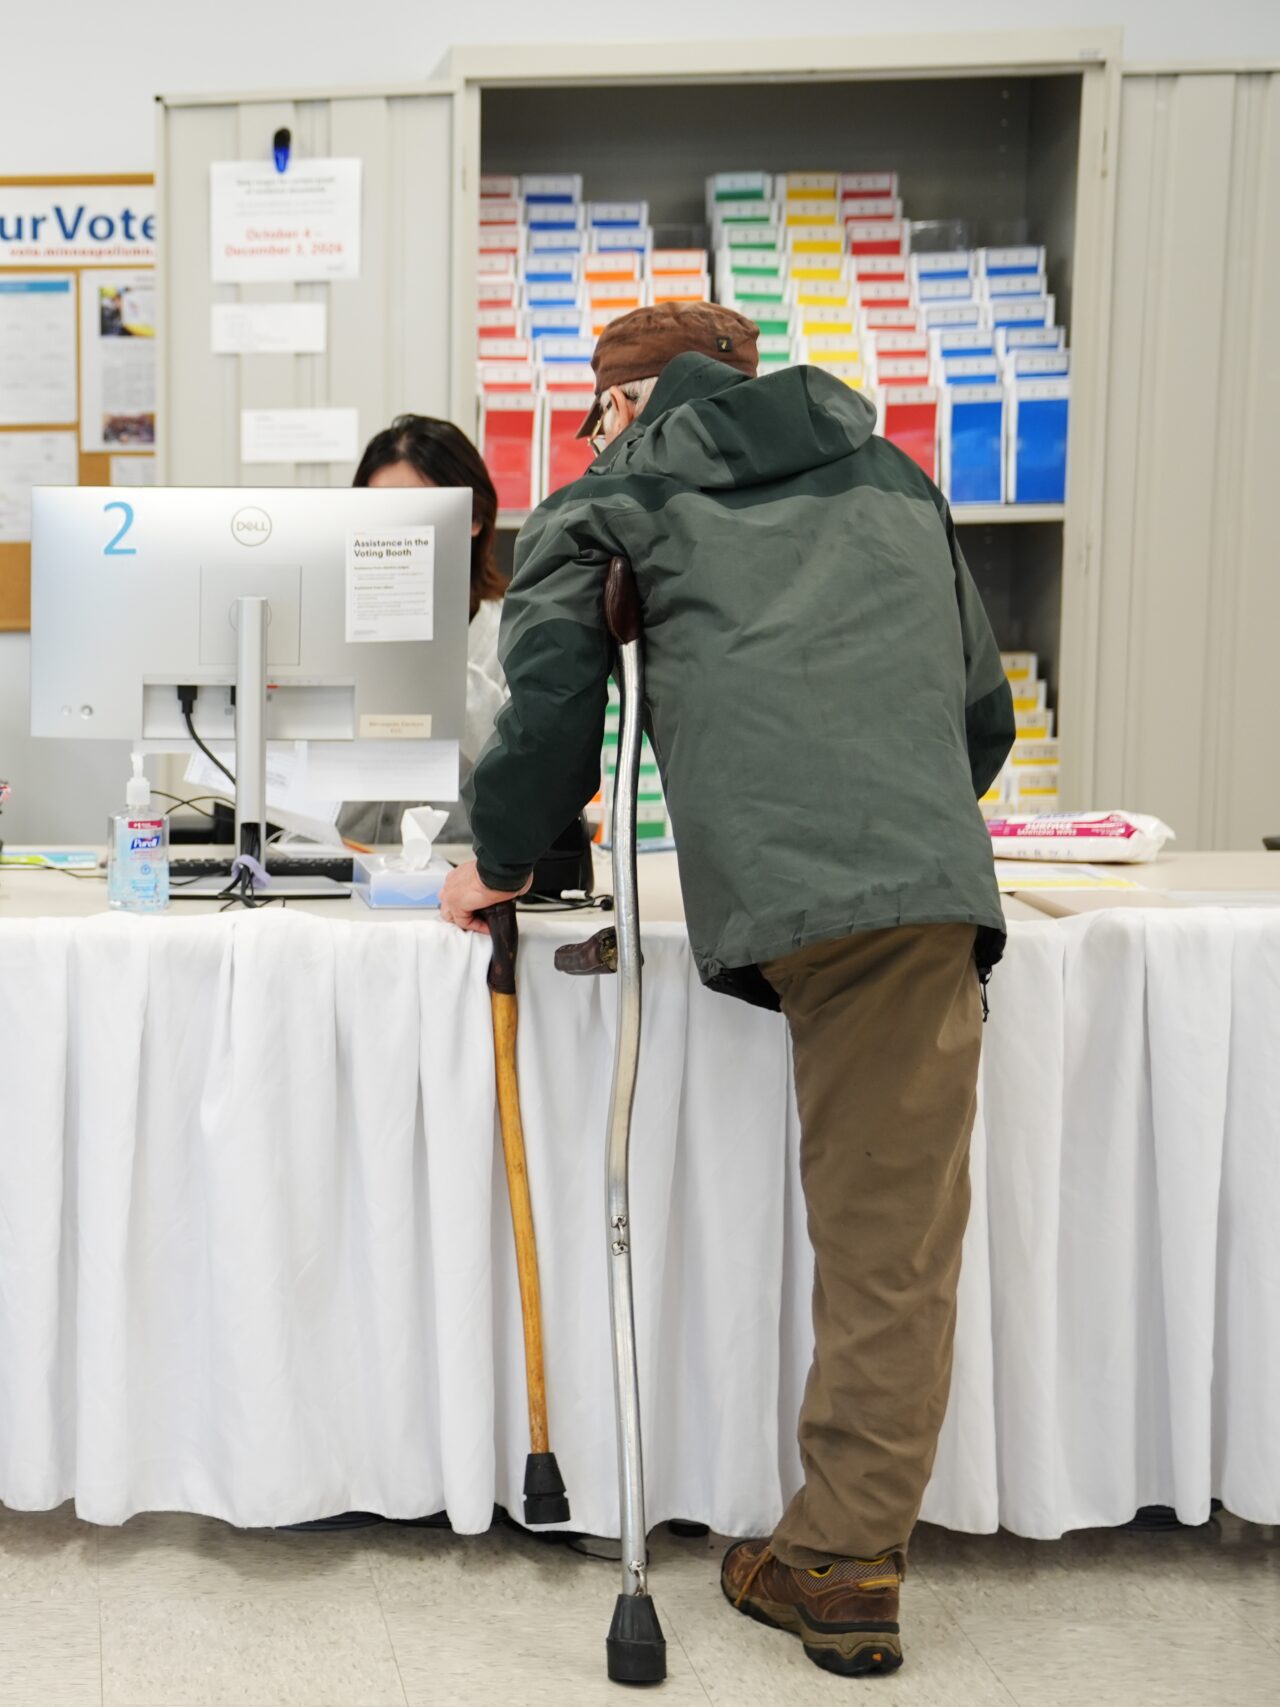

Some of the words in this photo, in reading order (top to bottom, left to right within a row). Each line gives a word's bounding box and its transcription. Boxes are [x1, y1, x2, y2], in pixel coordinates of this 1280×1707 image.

[245, 227, 299, 241] October
[224, 244, 290, 257] December
[103, 501, 137, 556] 2
[236, 520, 269, 533] DELL
[353, 538, 403, 548] Assistance
[404, 538, 413, 547] in
[414, 537, 430, 547] the
[353, 549, 384, 560] Voting
[385, 548, 412, 558] Booth
